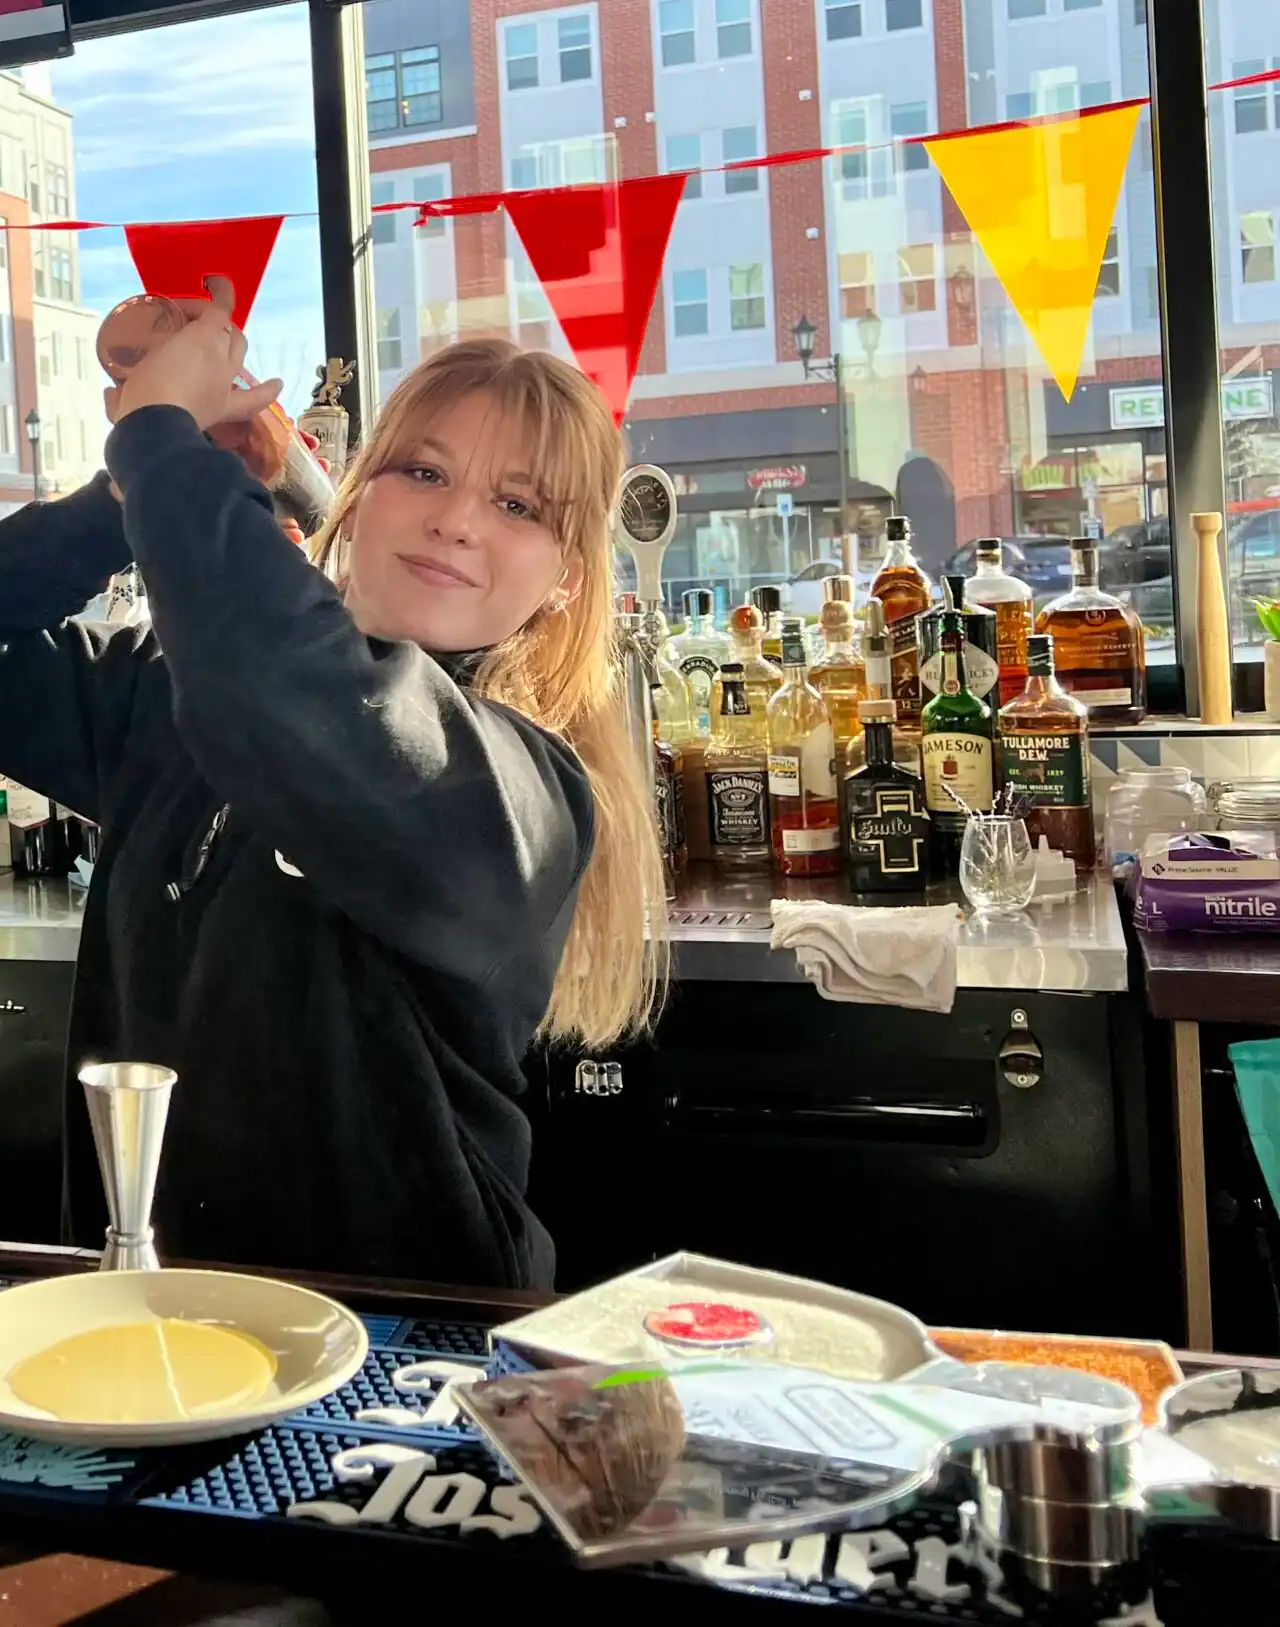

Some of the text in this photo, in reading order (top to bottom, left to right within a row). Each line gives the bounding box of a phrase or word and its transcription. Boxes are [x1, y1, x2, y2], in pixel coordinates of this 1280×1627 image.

[923, 739, 984, 754] JAMESON
[1002, 736, 1070, 749] TULLAMORE
[712, 776, 764, 794] JACK DANIEL'S
[721, 818, 758, 826] WHISKEY
[1152, 902, 1162, 915] L
[1204, 896, 1277, 916] nitrile
[287, 1443, 543, 1540] Jos
